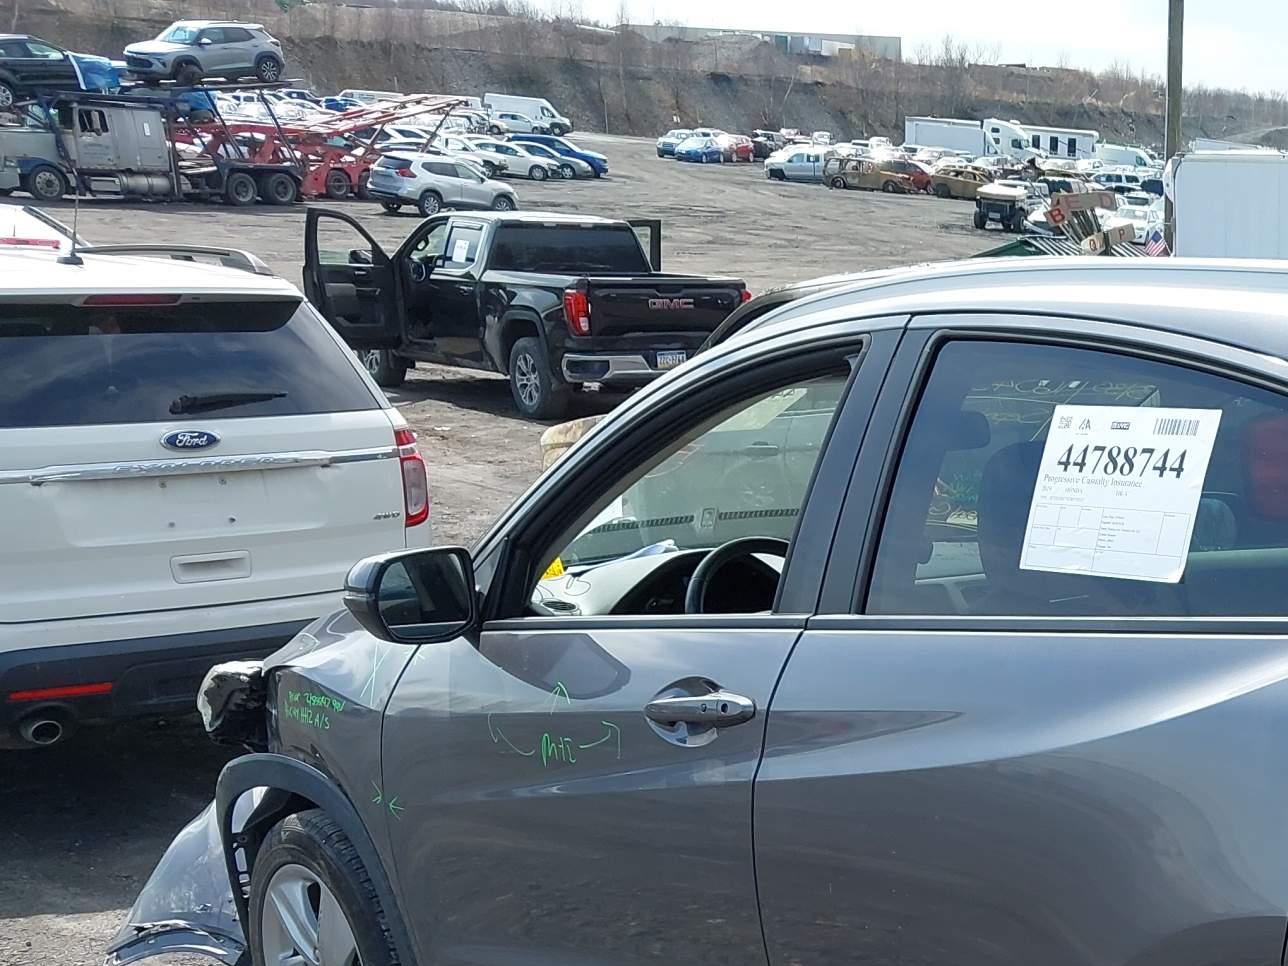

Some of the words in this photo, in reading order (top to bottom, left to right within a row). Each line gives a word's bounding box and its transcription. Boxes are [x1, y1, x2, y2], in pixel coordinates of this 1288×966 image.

[1049, 208, 1066, 223] B
[1118, 228, 1125, 241] P
[648, 298, 695, 309] GMC
[175, 432, 209, 447] Ford
[1057, 443, 1188, 479] 44788744
[1043, 473, 1081, 486] Progressive
[1081, 476, 1110, 488] Casualty
[1110, 477, 1144, 489] Insurance
[373, 511, 400, 520] 4WD
